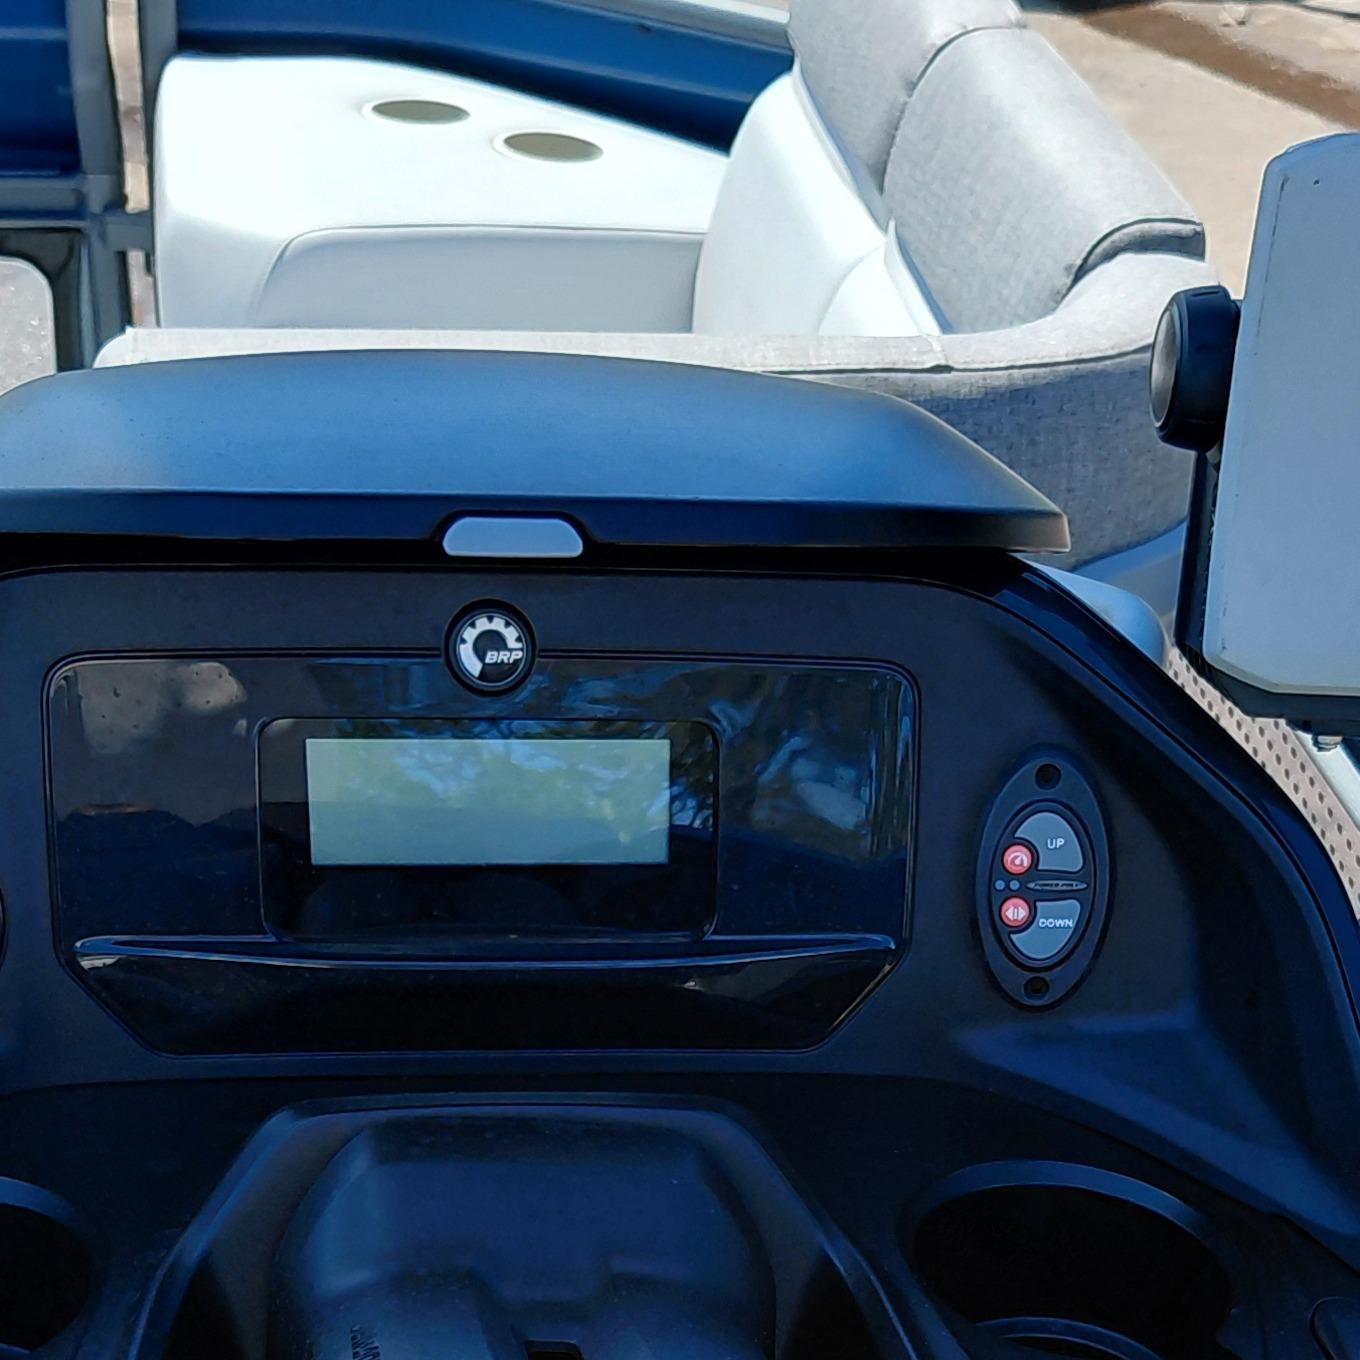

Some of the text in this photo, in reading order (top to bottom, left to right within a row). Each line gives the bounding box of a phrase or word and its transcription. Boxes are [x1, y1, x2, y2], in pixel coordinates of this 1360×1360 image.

[484, 650, 523, 664] BRP
[1047, 837, 1065, 849] UP
[1039, 918, 1073, 927] DOWN
